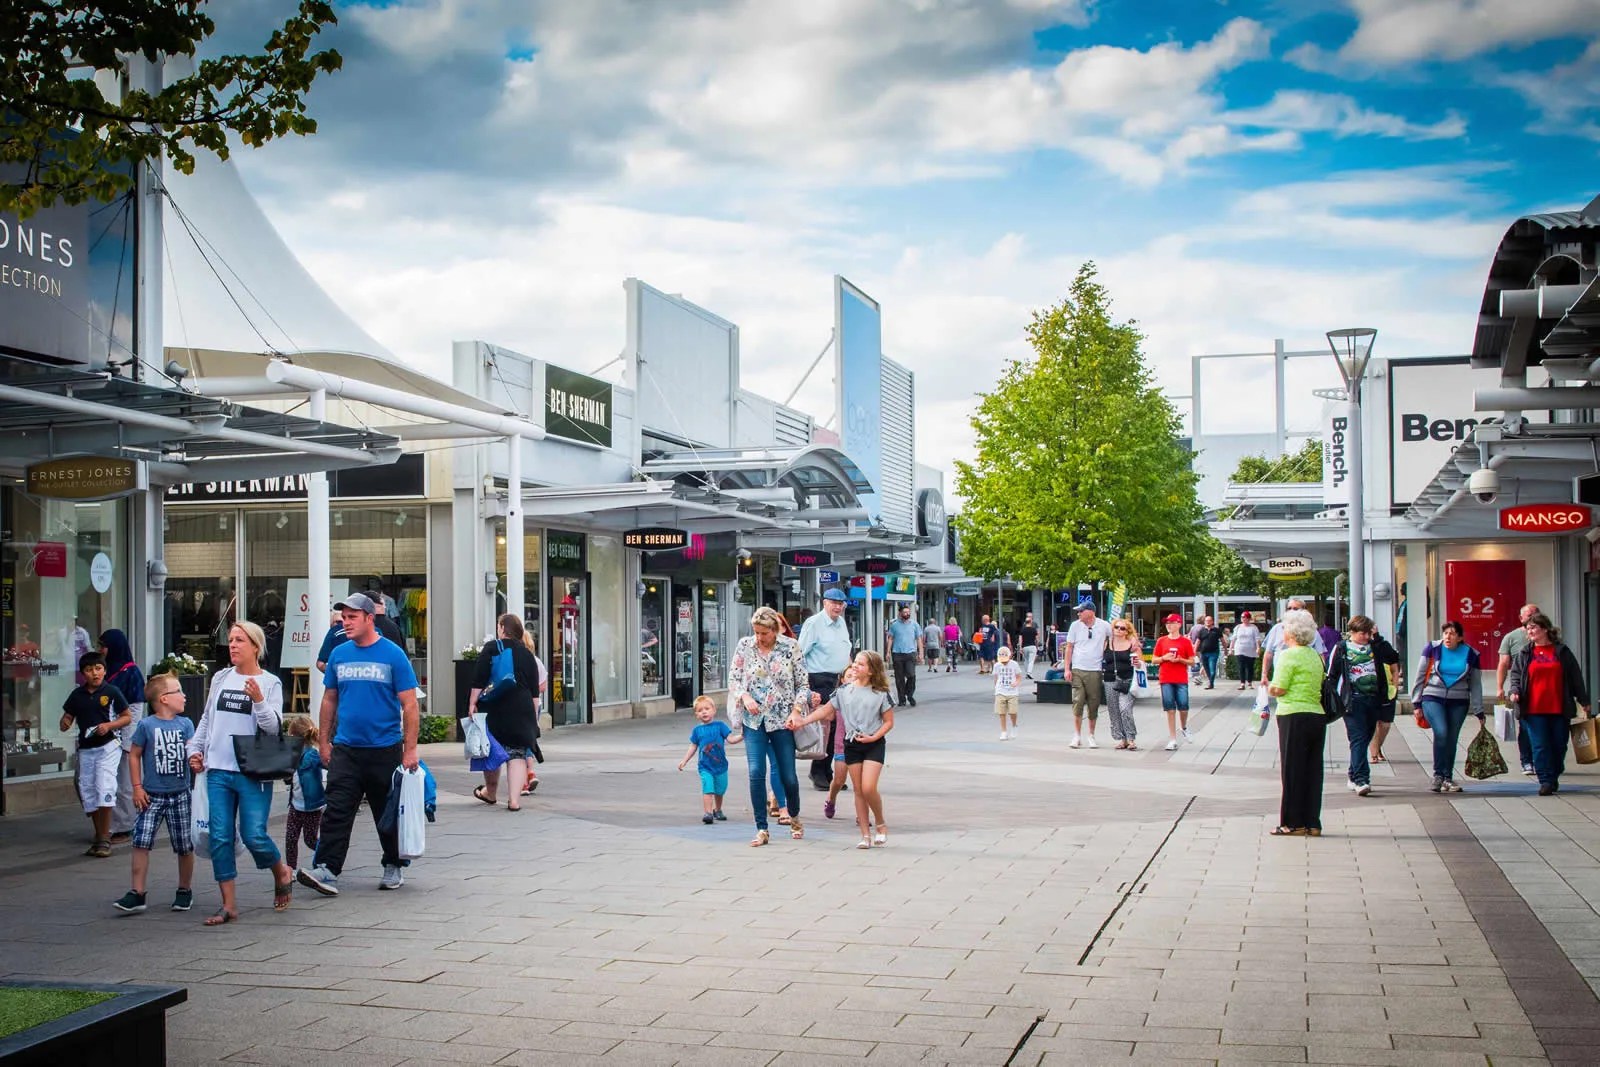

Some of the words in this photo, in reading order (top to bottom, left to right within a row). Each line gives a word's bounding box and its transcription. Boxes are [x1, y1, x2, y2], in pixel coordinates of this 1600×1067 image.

[550, 387, 566, 416] BEN
[569, 393, 606, 426] SHERMAN
[1401, 413, 1529, 442] Ben
[1332, 417, 1348, 488] Bench.
[31, 469, 83, 481] ERNEST
[88, 466, 132, 478] JONES
[1508, 511, 1583, 526] MANGO
[626, 535, 641, 545] BEN
[645, 535, 682, 545] SHERMAN
[549, 543, 558, 558] BEN
[559, 543, 581, 559] SHERMAN
[794, 553, 816, 565] hmv
[867, 561, 888, 571] hmv
[1269, 560, 1304, 568] Bench.
[1460, 597, 1473, 614] 3
[1482, 597, 1495, 614] 2
[337, 664, 385, 679] Bench.
